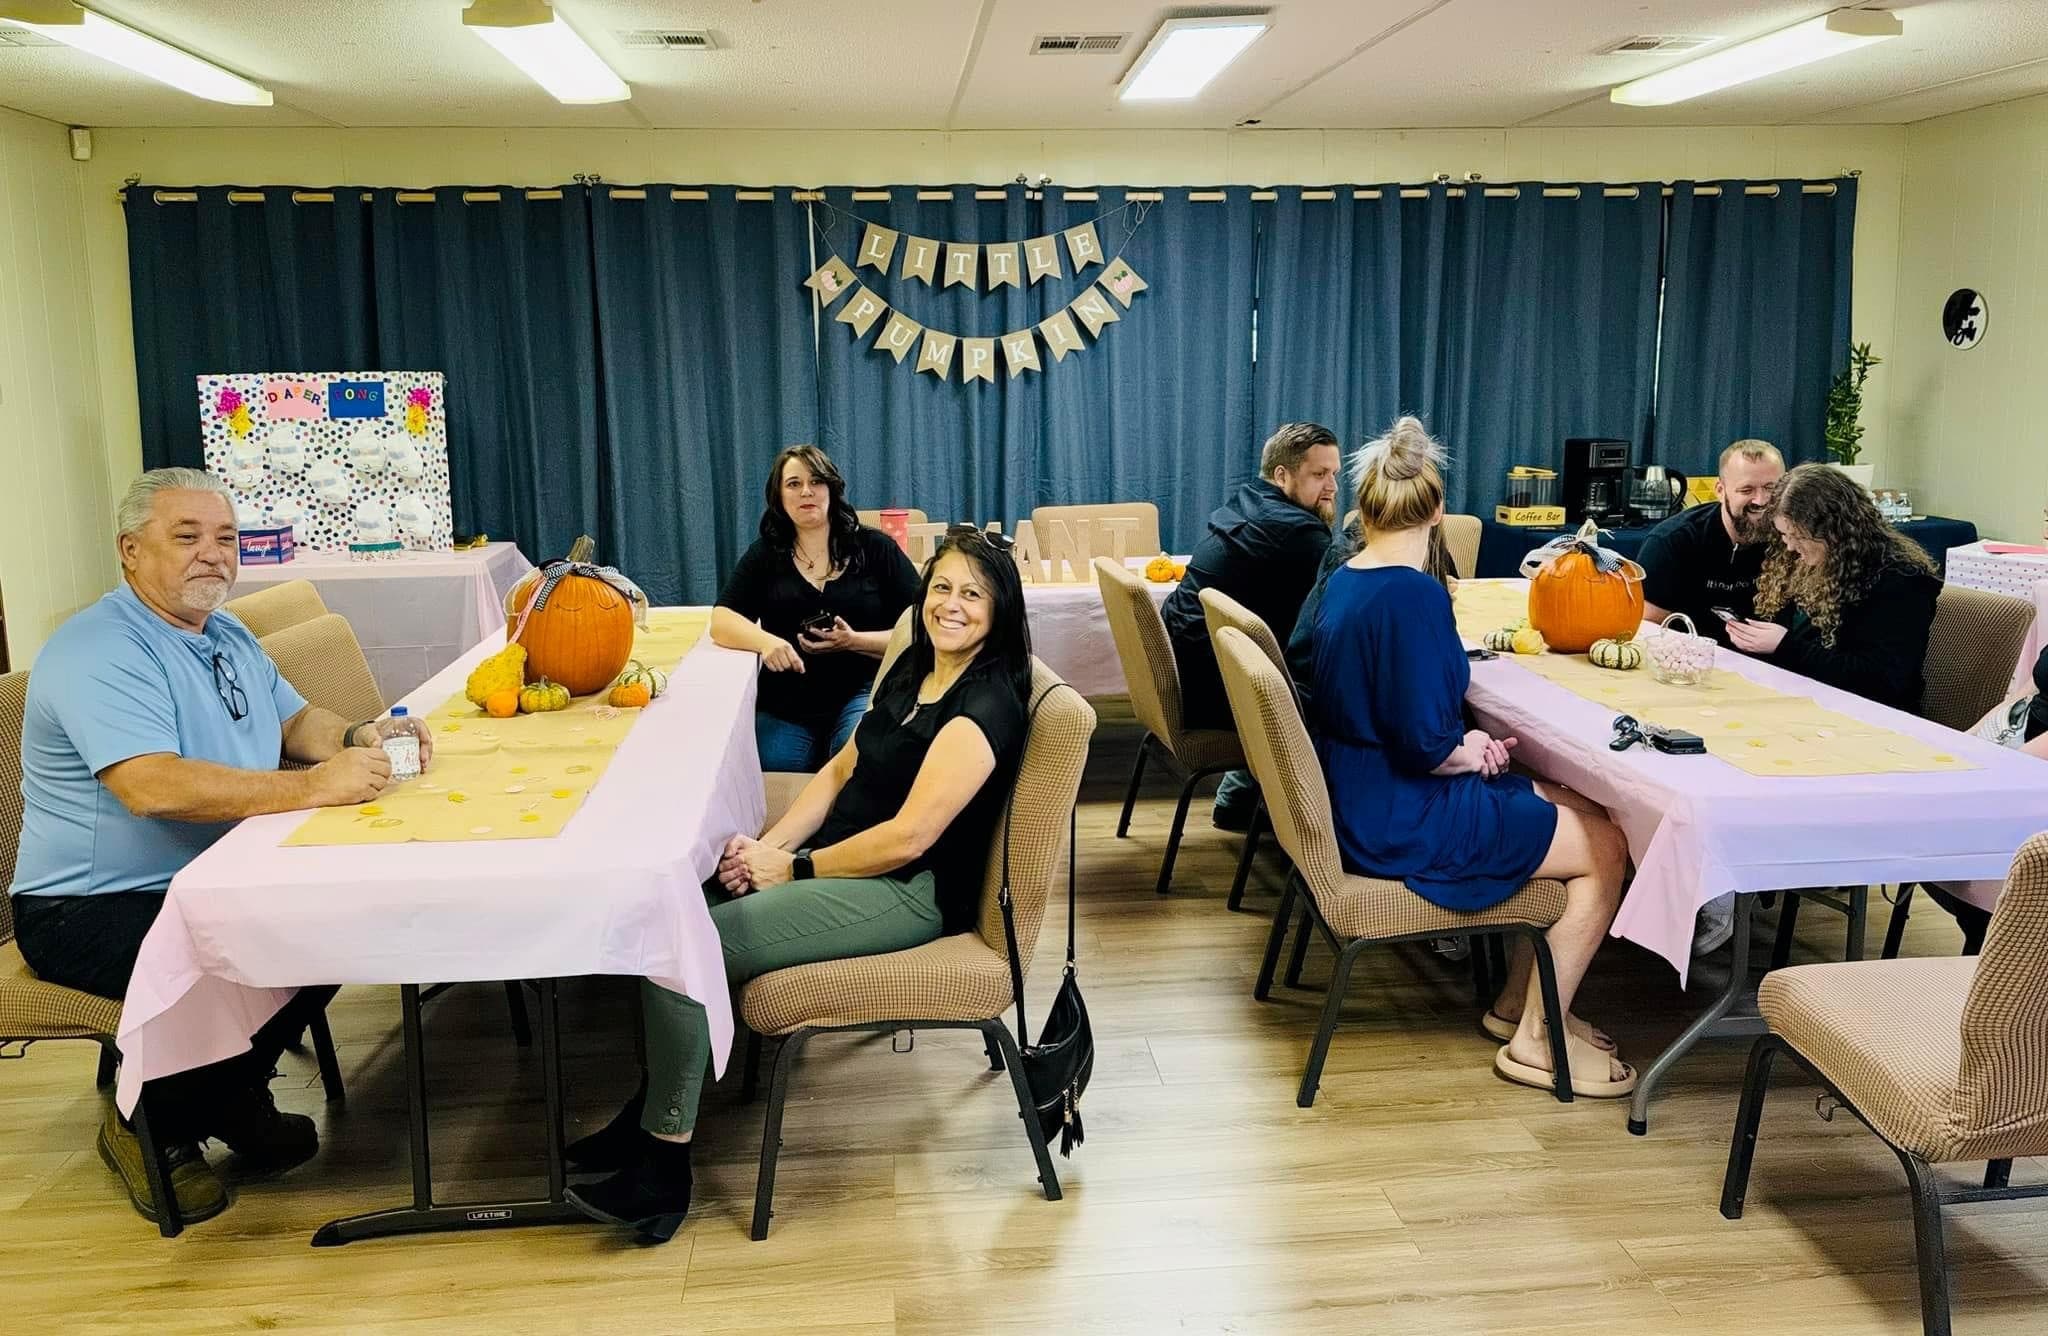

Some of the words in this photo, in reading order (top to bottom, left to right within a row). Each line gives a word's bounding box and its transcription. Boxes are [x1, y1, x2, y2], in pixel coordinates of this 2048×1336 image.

[870, 232, 1094, 276] LITTLE
[853, 296, 1106, 369] PUMPKIN
[1515, 511, 1542, 522] Coffee
[1546, 511, 1561, 521] Bar
